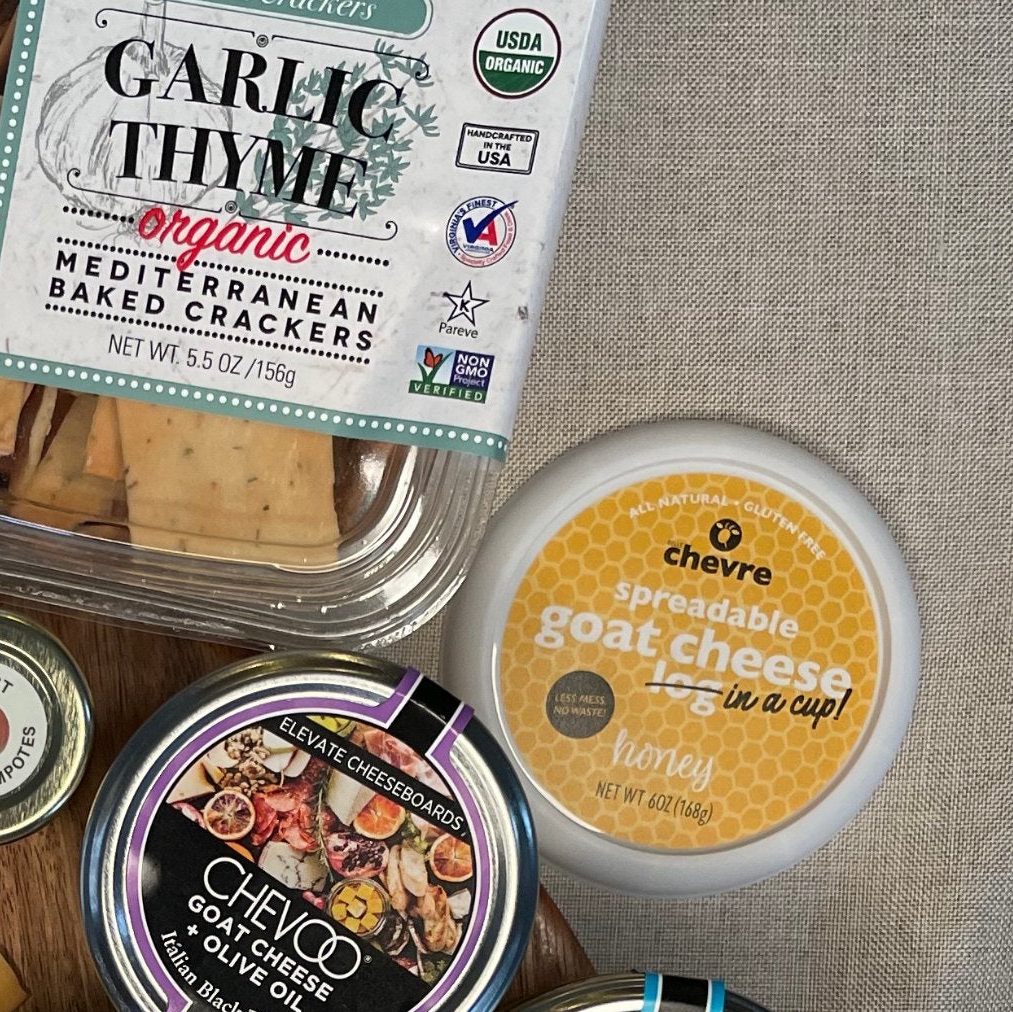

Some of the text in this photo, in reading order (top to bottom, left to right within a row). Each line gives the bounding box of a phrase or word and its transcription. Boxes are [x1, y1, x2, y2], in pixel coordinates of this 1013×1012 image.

[261, 0, 377, 20] ackers
[496, 30, 542, 52] USDA
[485, 56, 544, 75] ORGANIC
[104, 38, 404, 141] GARLIC
[467, 129, 532, 143] HANDCRAFTED
[495, 143, 512, 151] THE
[109, 120, 368, 218] THYME
[478, 151, 511, 167] USA
[466, 199, 498, 211] FINEST
[138, 207, 311, 272] organic
[56, 251, 378, 323] MEDITERRANEAN
[460, 299, 470, 313] K
[48, 277, 373, 351] BAKED CRACKERS
[438, 322, 479, 339] Pareve
[108, 334, 297, 388] NET WT. 5.5 OZ /156g
[453, 374, 486, 389] Project
[455, 364, 488, 377] GMO
[457, 354, 490, 368] NON
[413, 383, 483, 401] VERIFIED
[628, 492, 826, 561] ALL NATURAL GLUTEN FREE
[664, 544, 772, 586] chevre
[614, 581, 800, 640] spreadable
[534, 604, 853, 699] goat cheese
[553, 706, 569, 716] NO
[555, 693, 605, 705] LESS MESS
[649, 660, 854, 730] log in a cup!
[278, 716, 464, 831] ELEVATE CHEESEBOARDS
[612, 728, 715, 793] honey
[596, 780, 622, 801] NET
[623, 788, 646, 806] WT
[203, 856, 362, 981] CHEVOO
[160, 930, 198, 986] Italian
[186, 923, 199, 937] +
[202, 934, 265, 987] OLIVE
[188, 894, 334, 1002] GOAT CHEESE
